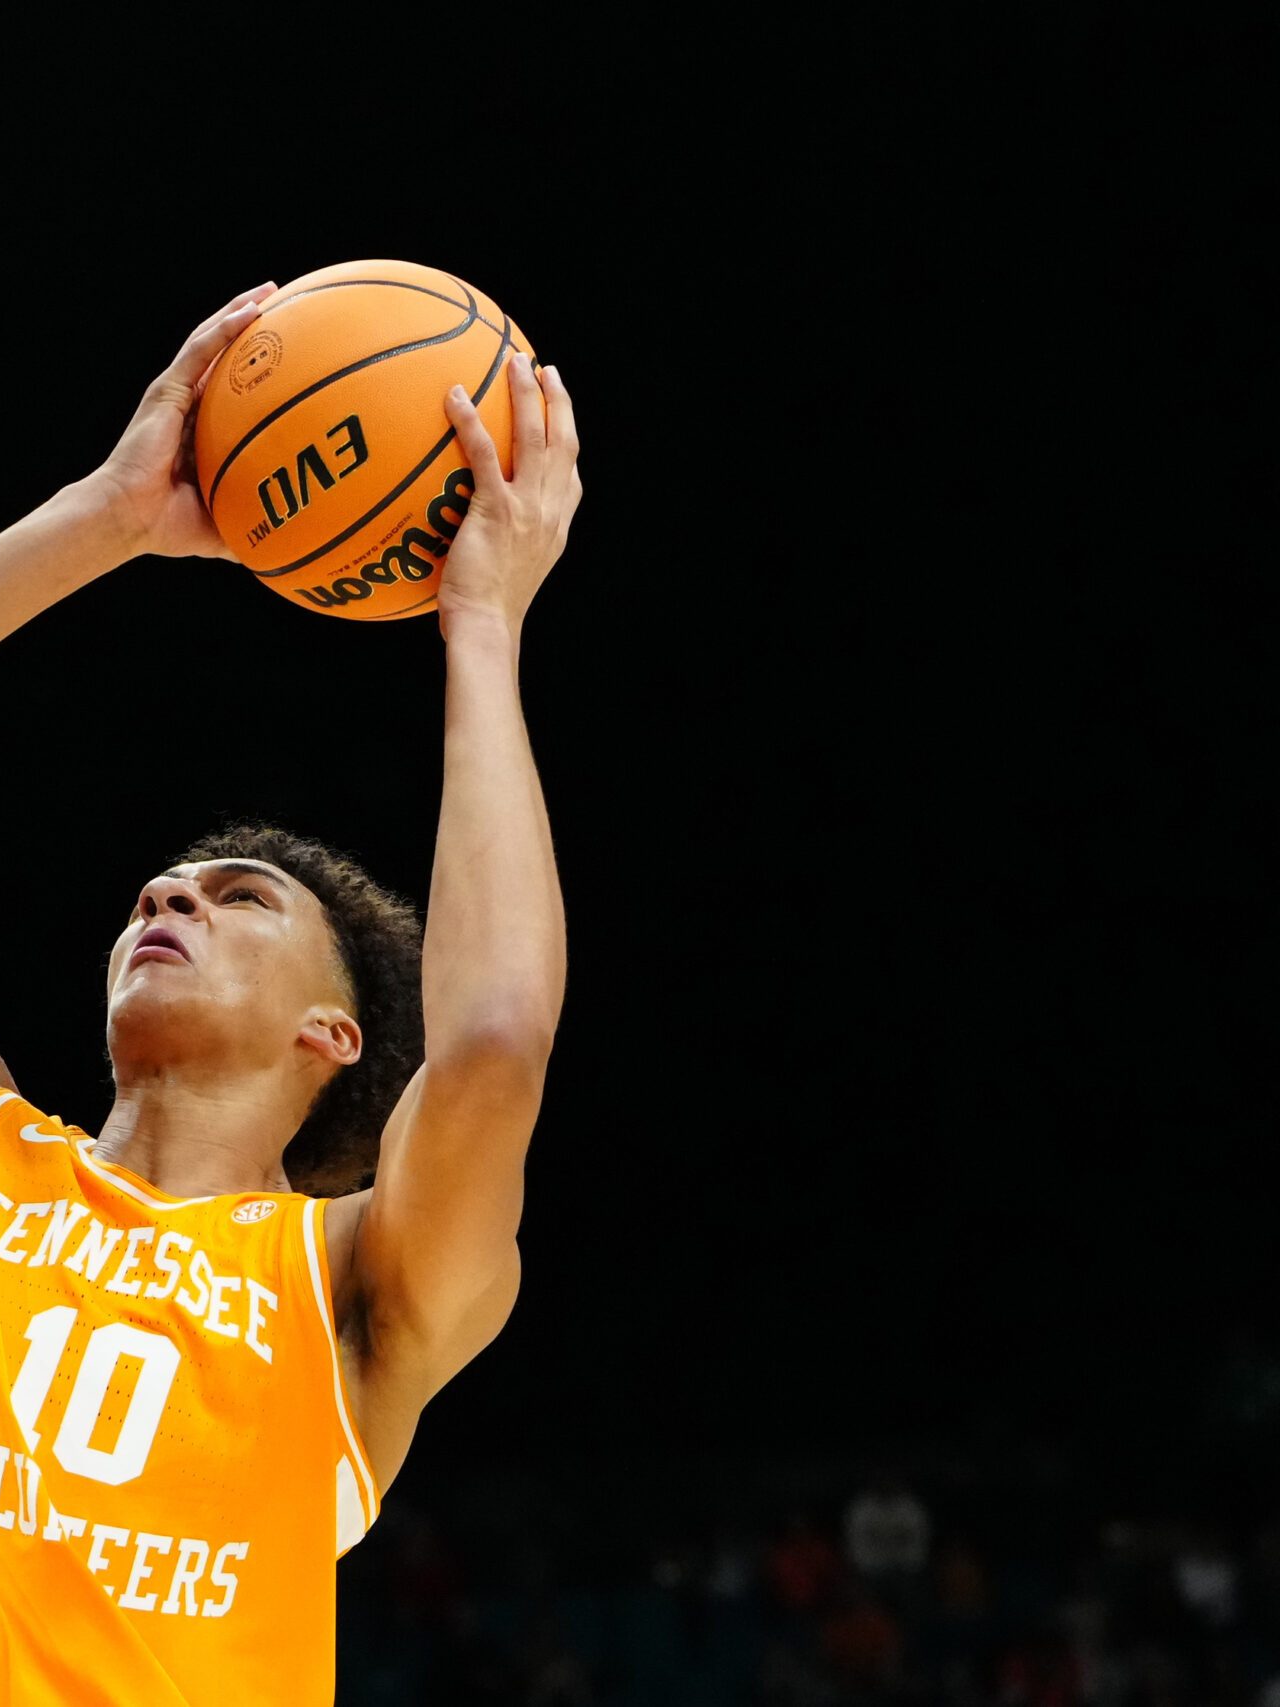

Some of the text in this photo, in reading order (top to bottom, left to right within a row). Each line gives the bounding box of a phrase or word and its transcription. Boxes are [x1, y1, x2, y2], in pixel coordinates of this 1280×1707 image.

[246, 412, 369, 549] EVO NXT
[353, 545, 379, 565] GAME
[232, 1201, 277, 1223] SEC
[10, 1305, 181, 1486] 10
